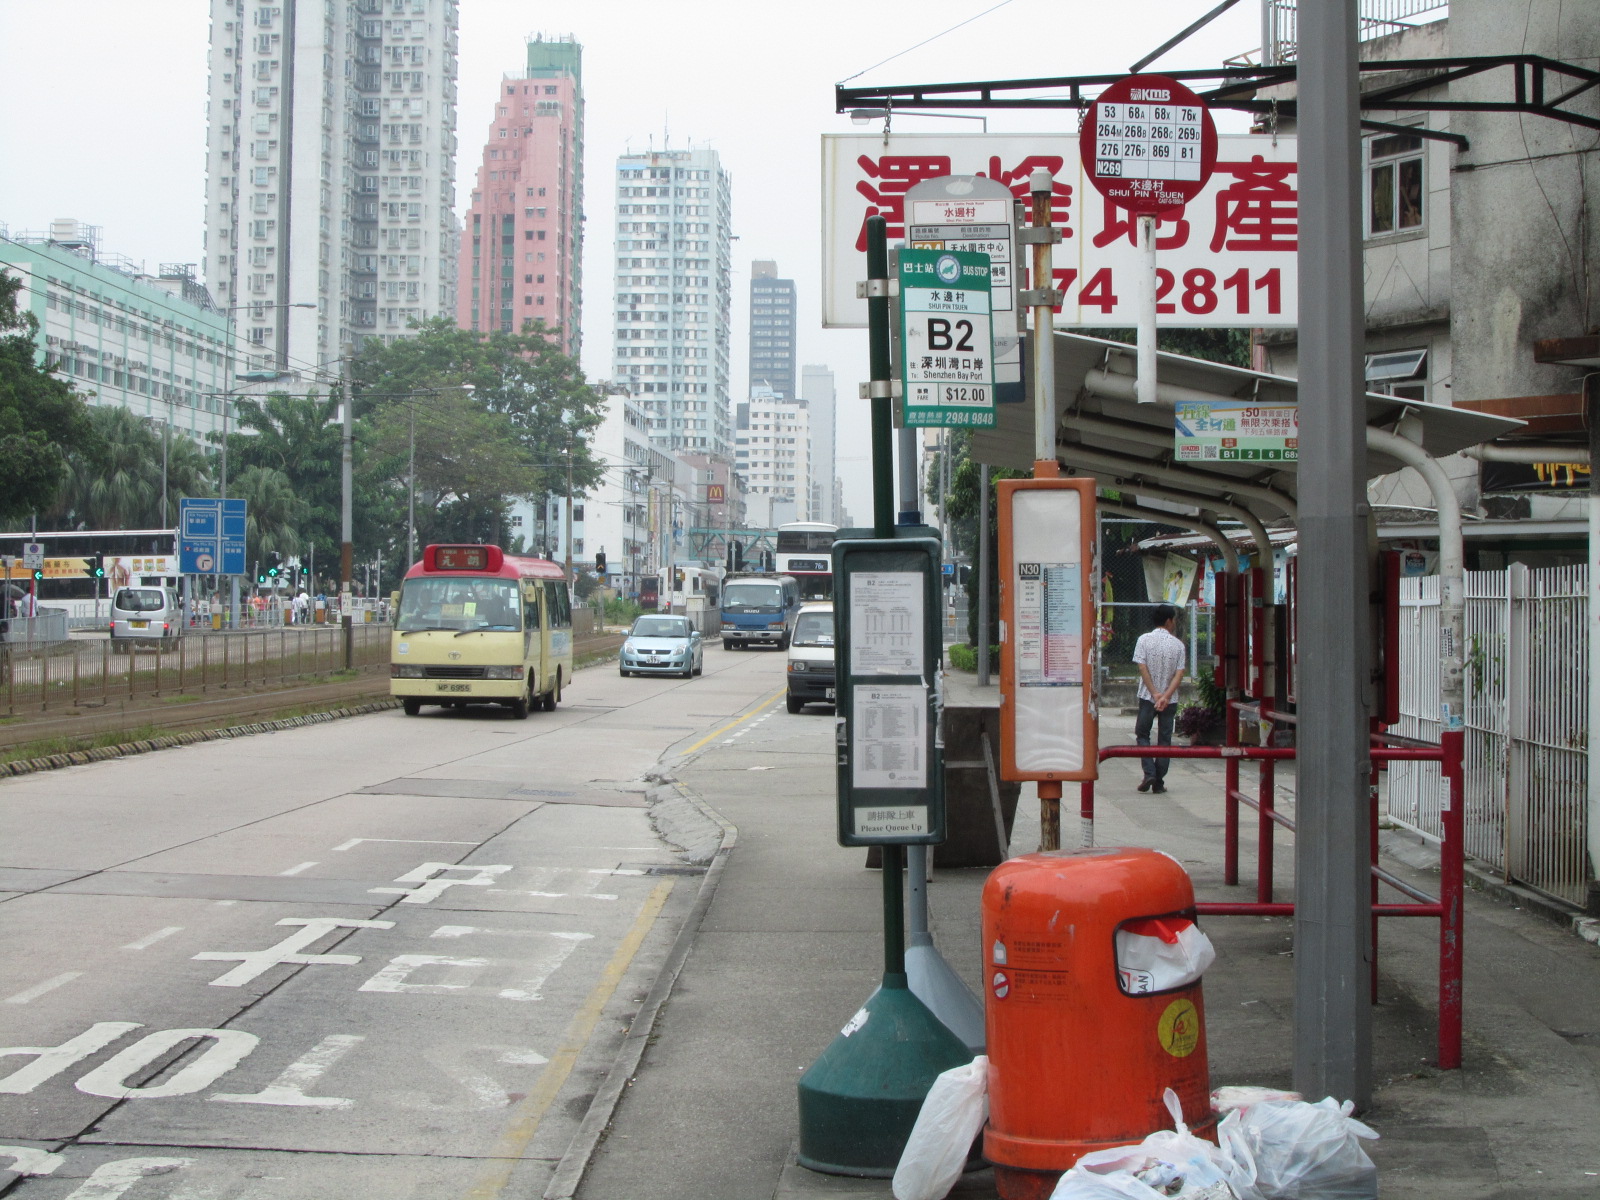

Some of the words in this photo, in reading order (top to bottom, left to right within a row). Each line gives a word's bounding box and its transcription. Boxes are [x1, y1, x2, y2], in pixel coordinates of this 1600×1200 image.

[1104, 106, 1116, 118] 53
[1128, 107, 1145, 120] 68A
[1154, 107, 1170, 120] 68X
[1181, 109, 1197, 122] 76K
[1098, 125, 1121, 138] 264M
[1124, 126, 1147, 139] 268B
[1151, 127, 1173, 140] 268C
[1178, 128, 1200, 141] 269D
[1101, 143, 1119, 156] 276
[1124, 144, 1146, 157] 276P
[1152, 145, 1170, 158] 869
[1097, 161, 1121, 176] N269
[1130, 179, 1164, 191] 水邊村
[1108, 189, 1130, 197] SHUI
[1134, 190, 1150, 198] PIN
[1153, 191, 1184, 199] TSUEN
[944, 207, 976, 218] 水邊村
[903, 263, 934, 273] 巴士站
[962, 266, 974, 276] BUS
[974, 267, 988, 277] STOP
[930, 291, 965, 303] 水邊村
[1156, 268, 1281, 314] 2811
[928, 317, 974, 351] B2
[921, 357, 984, 371] 深圳灣口岸
[923, 371, 956, 379] Shenzhen
[957, 371, 969, 381] Bay
[970, 372, 983, 380] Port
[946, 387, 985, 402] $12.00
[945, 412, 969, 424] 2984
[971, 413, 994, 425] 9848
[1240, 418, 1291, 428] 無限次乘搭
[1223, 450, 1235, 458] B1
[1020, 564, 1039, 575] N30
[867, 810, 915, 821] 請排隊上車
[861, 824, 884, 832] Please
[885, 824, 910, 832] Queue
[911, 824, 922, 832] Up
